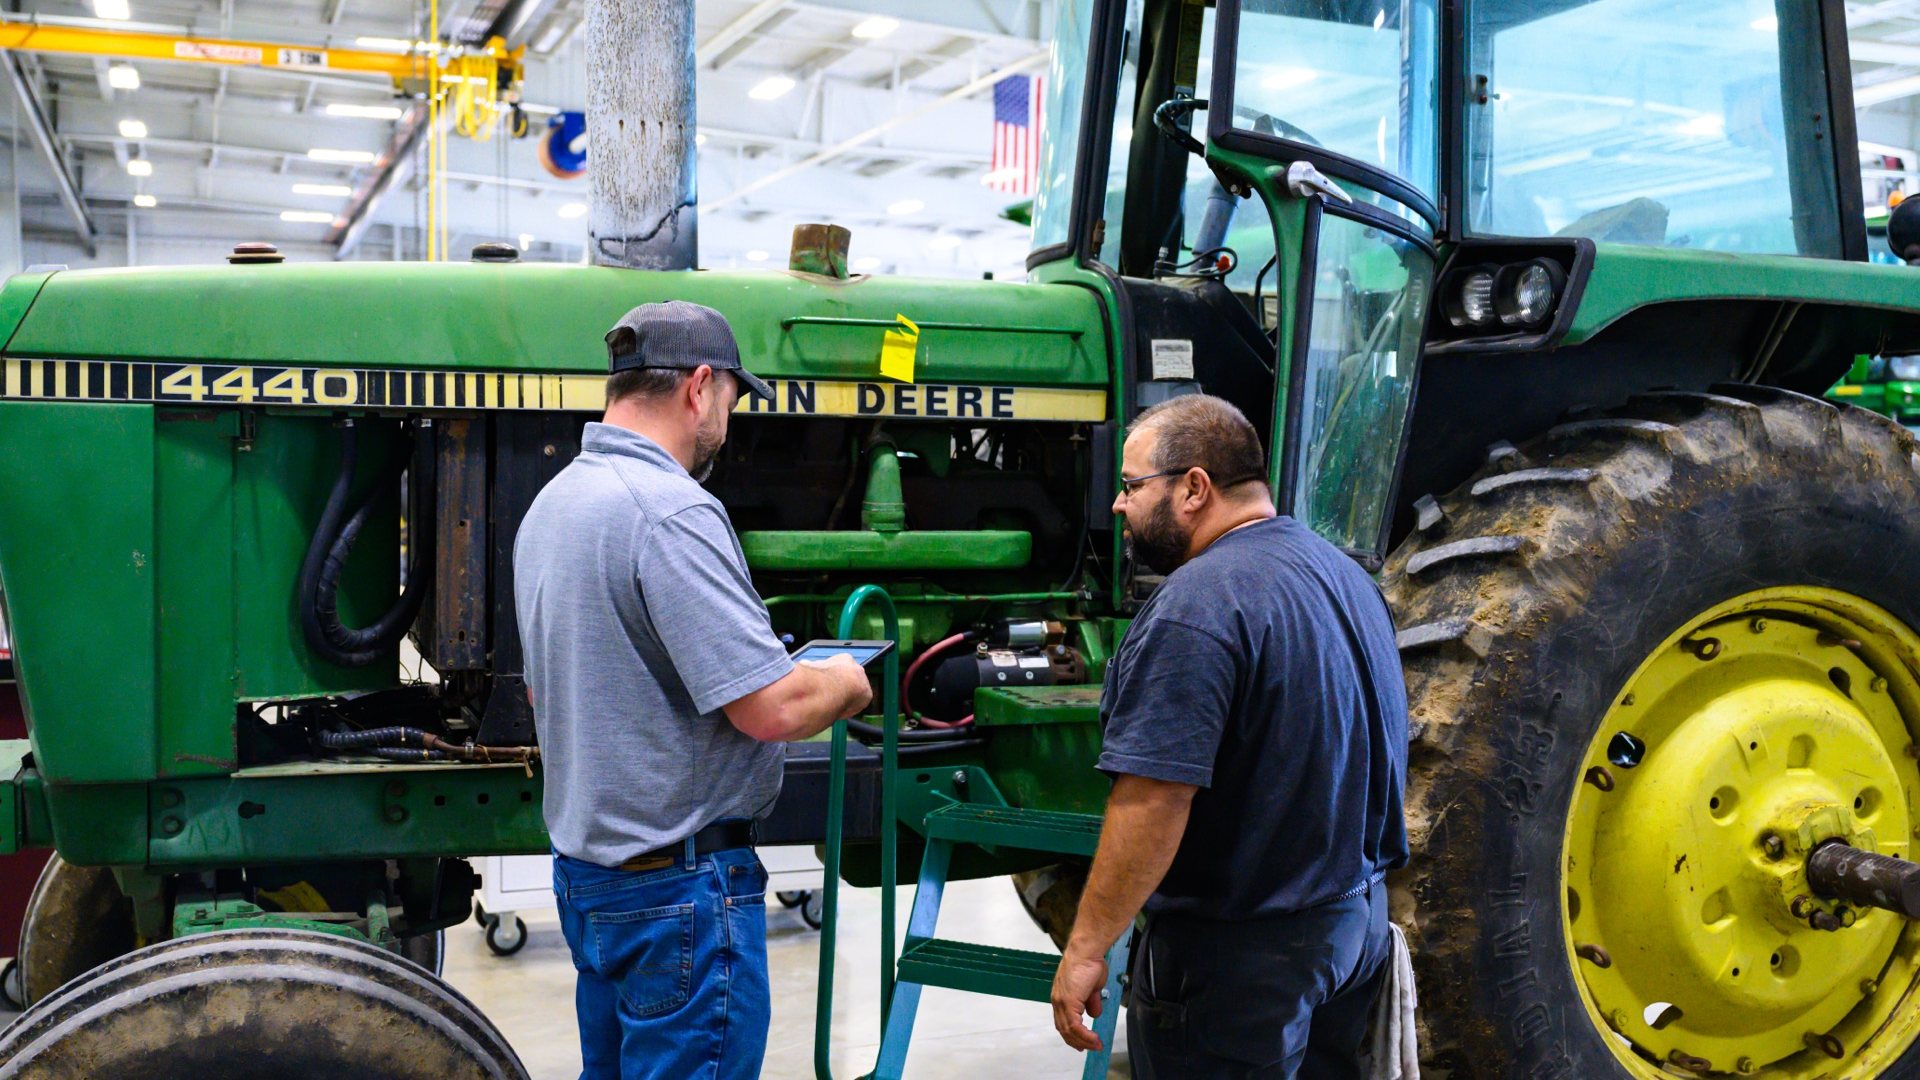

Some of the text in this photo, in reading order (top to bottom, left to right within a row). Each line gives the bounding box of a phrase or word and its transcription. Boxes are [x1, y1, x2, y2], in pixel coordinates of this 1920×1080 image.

[161, 365, 359, 405] 4440
[749, 381, 1015, 418] HN DEERE
[1488, 872, 1573, 1080] ADIAL
